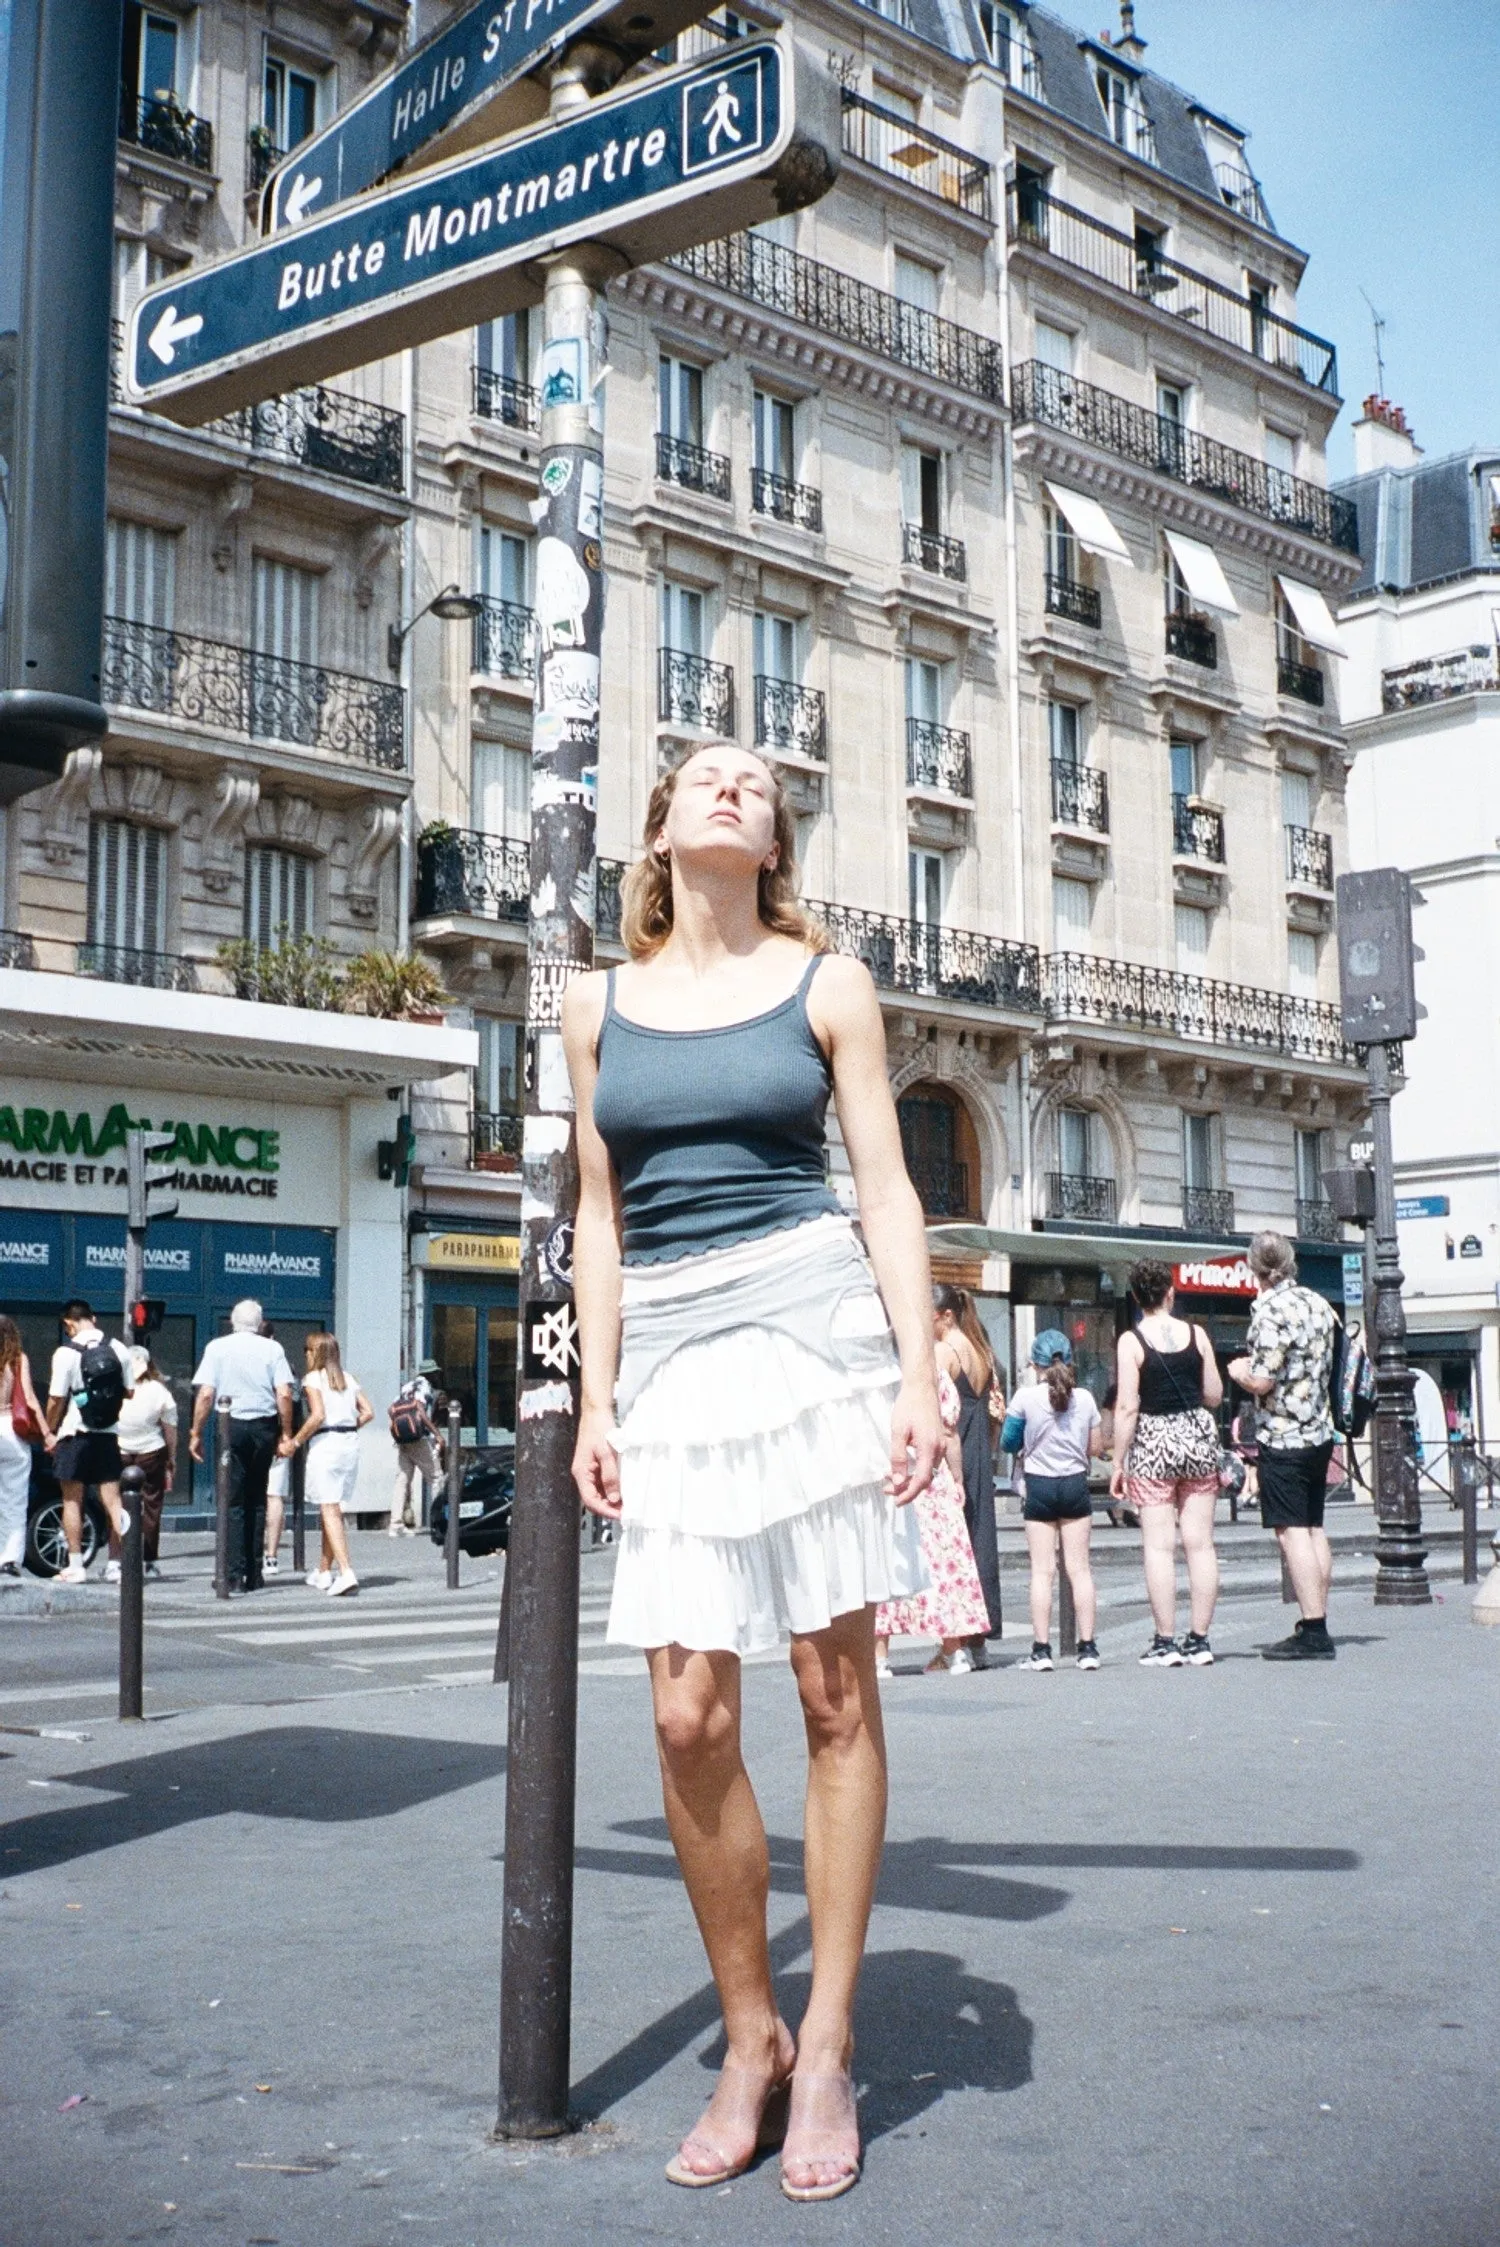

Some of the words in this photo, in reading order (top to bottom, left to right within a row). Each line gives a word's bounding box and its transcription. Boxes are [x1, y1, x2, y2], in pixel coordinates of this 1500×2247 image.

[393, 56, 465, 140] Halle
[278, 240, 385, 311] Butte
[404, 127, 667, 261] Montmartre
[530, 966, 580, 993] 2LU
[75, 1164, 96, 1184] ET
[103, 1166, 278, 1198] PAHARMACIE
